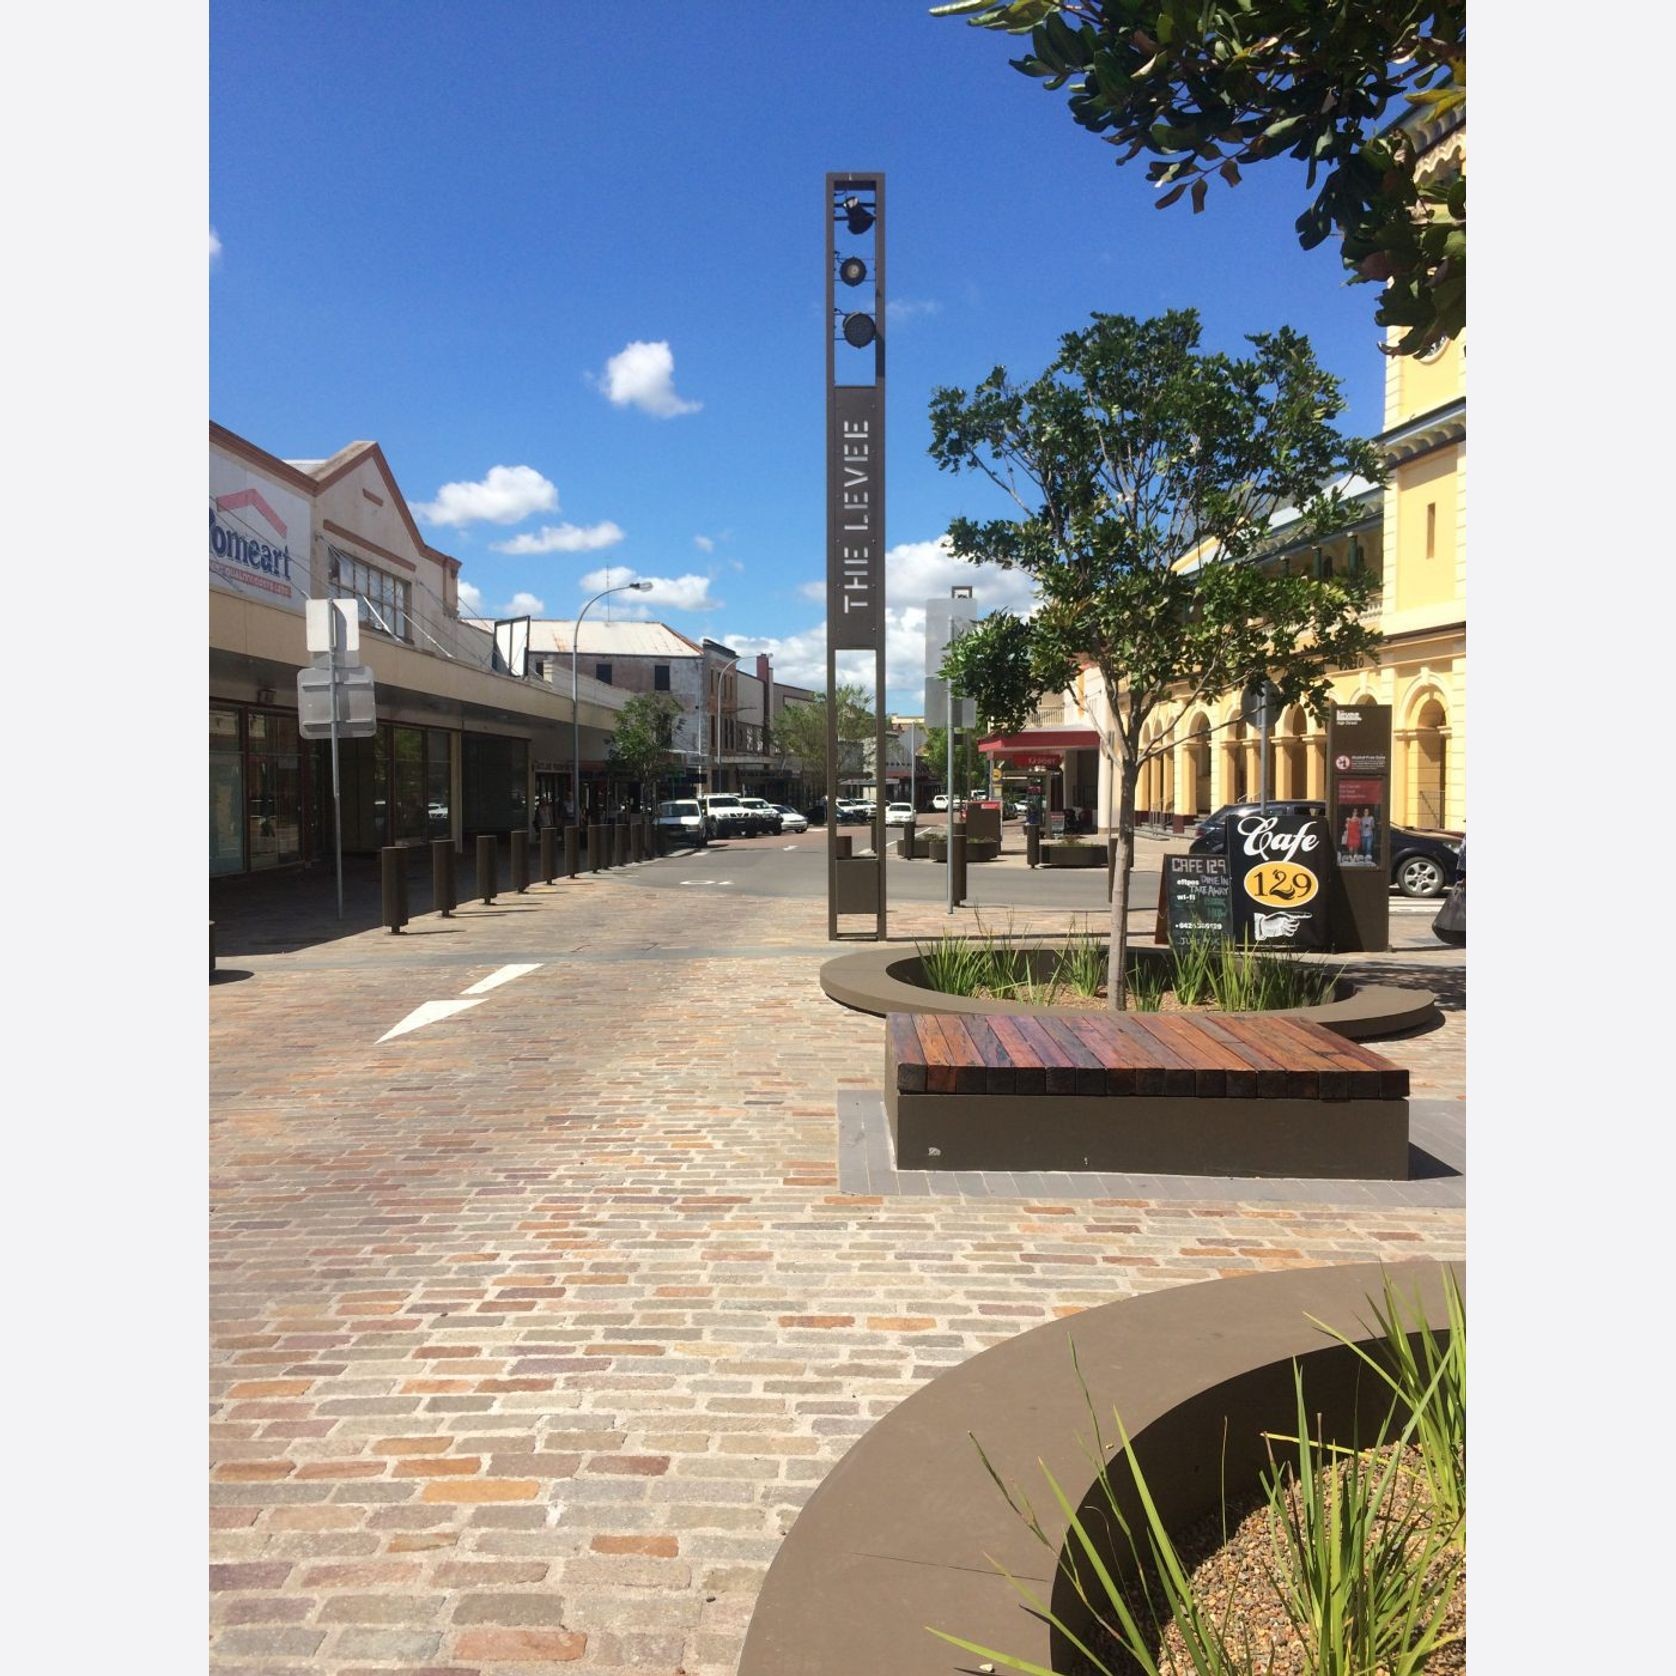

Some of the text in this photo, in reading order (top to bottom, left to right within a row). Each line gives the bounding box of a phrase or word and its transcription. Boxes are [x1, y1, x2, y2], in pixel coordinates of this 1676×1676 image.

[844, 420, 868, 614] THE LEVEE
[1237, 816, 1320, 863] Cafe
[1172, 857, 1226, 874] CAFE 129
[1253, 869, 1312, 900] 129
